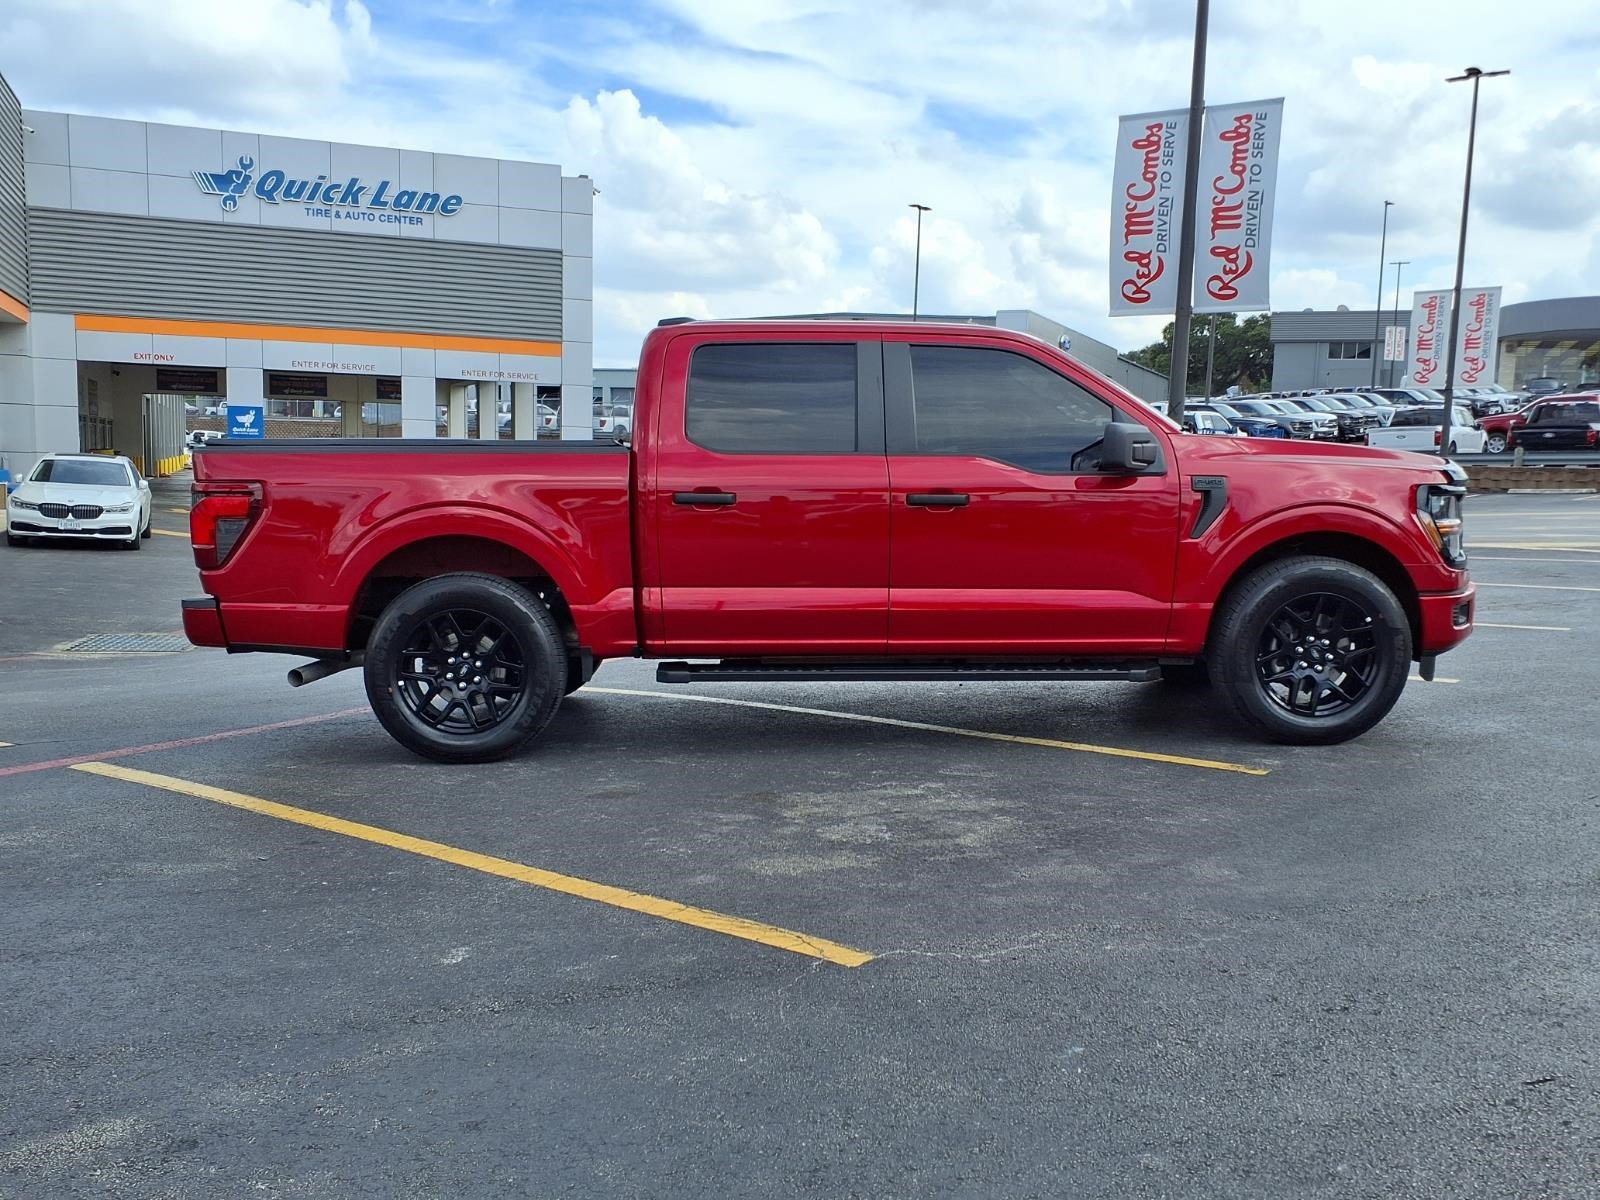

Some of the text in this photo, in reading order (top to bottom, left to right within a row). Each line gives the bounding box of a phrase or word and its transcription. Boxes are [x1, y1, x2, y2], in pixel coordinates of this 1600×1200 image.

[254, 169, 465, 216] Quick Lane
[1156, 121, 1177, 253] DRIVEN TO SERVE
[1245, 112, 1267, 248] DRIVEN TO SERVE
[304, 207, 424, 226] TIRE & AUTO CENTER
[1121, 122, 1165, 304] Red McCombs
[1206, 113, 1253, 300] Red McCombs
[133, 352, 175, 362] EXIT ONLY
[291, 360, 376, 372] ENTER FOR SERVICE
[1413, 357, 1438, 384] Red
[1460, 357, 1486, 383] Red
[461, 369, 539, 380] ENTER FOR SERVICE
